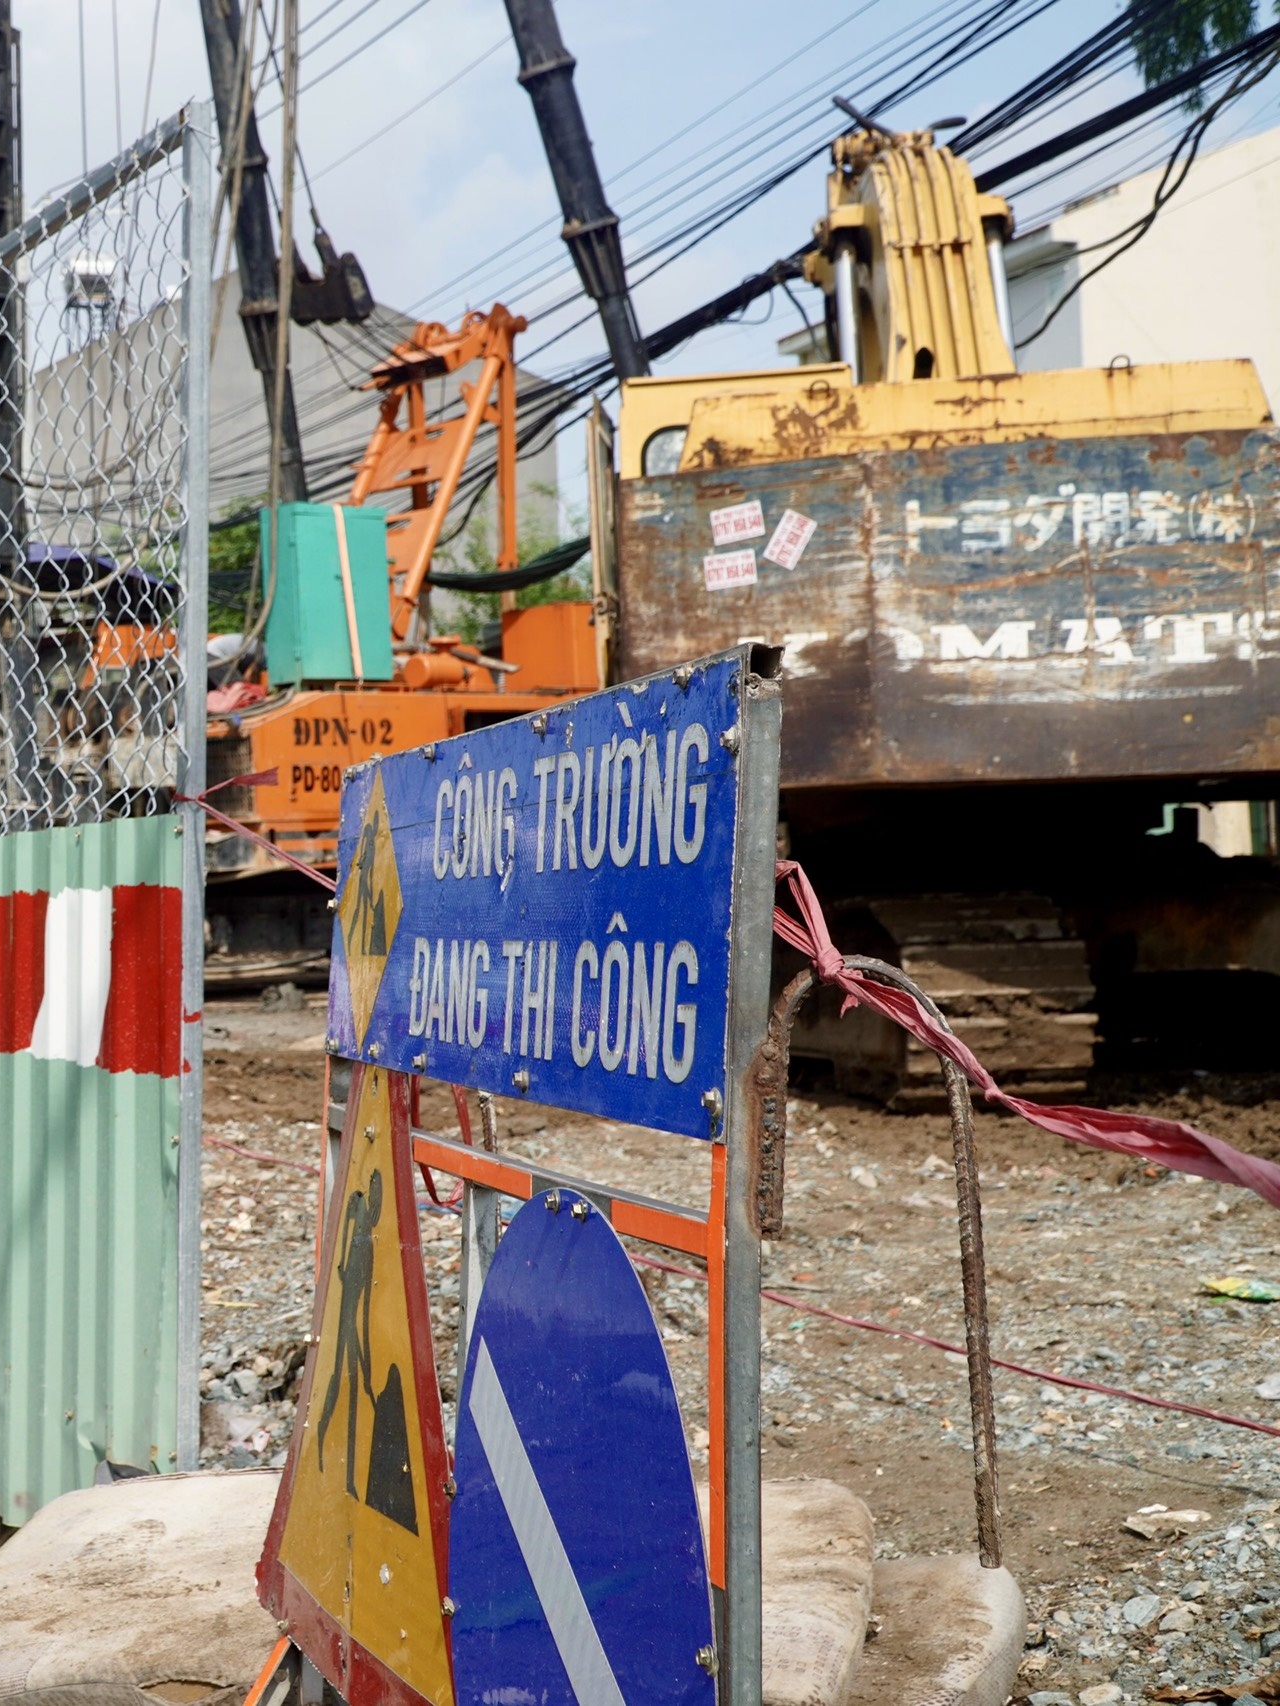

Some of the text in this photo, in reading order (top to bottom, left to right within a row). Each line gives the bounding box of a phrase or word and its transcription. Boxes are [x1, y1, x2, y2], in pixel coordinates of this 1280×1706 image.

[433, 702, 710, 881] CÔNG TRƯỜNG
[408, 912, 699, 1084] ĐANG THI CÔNG
